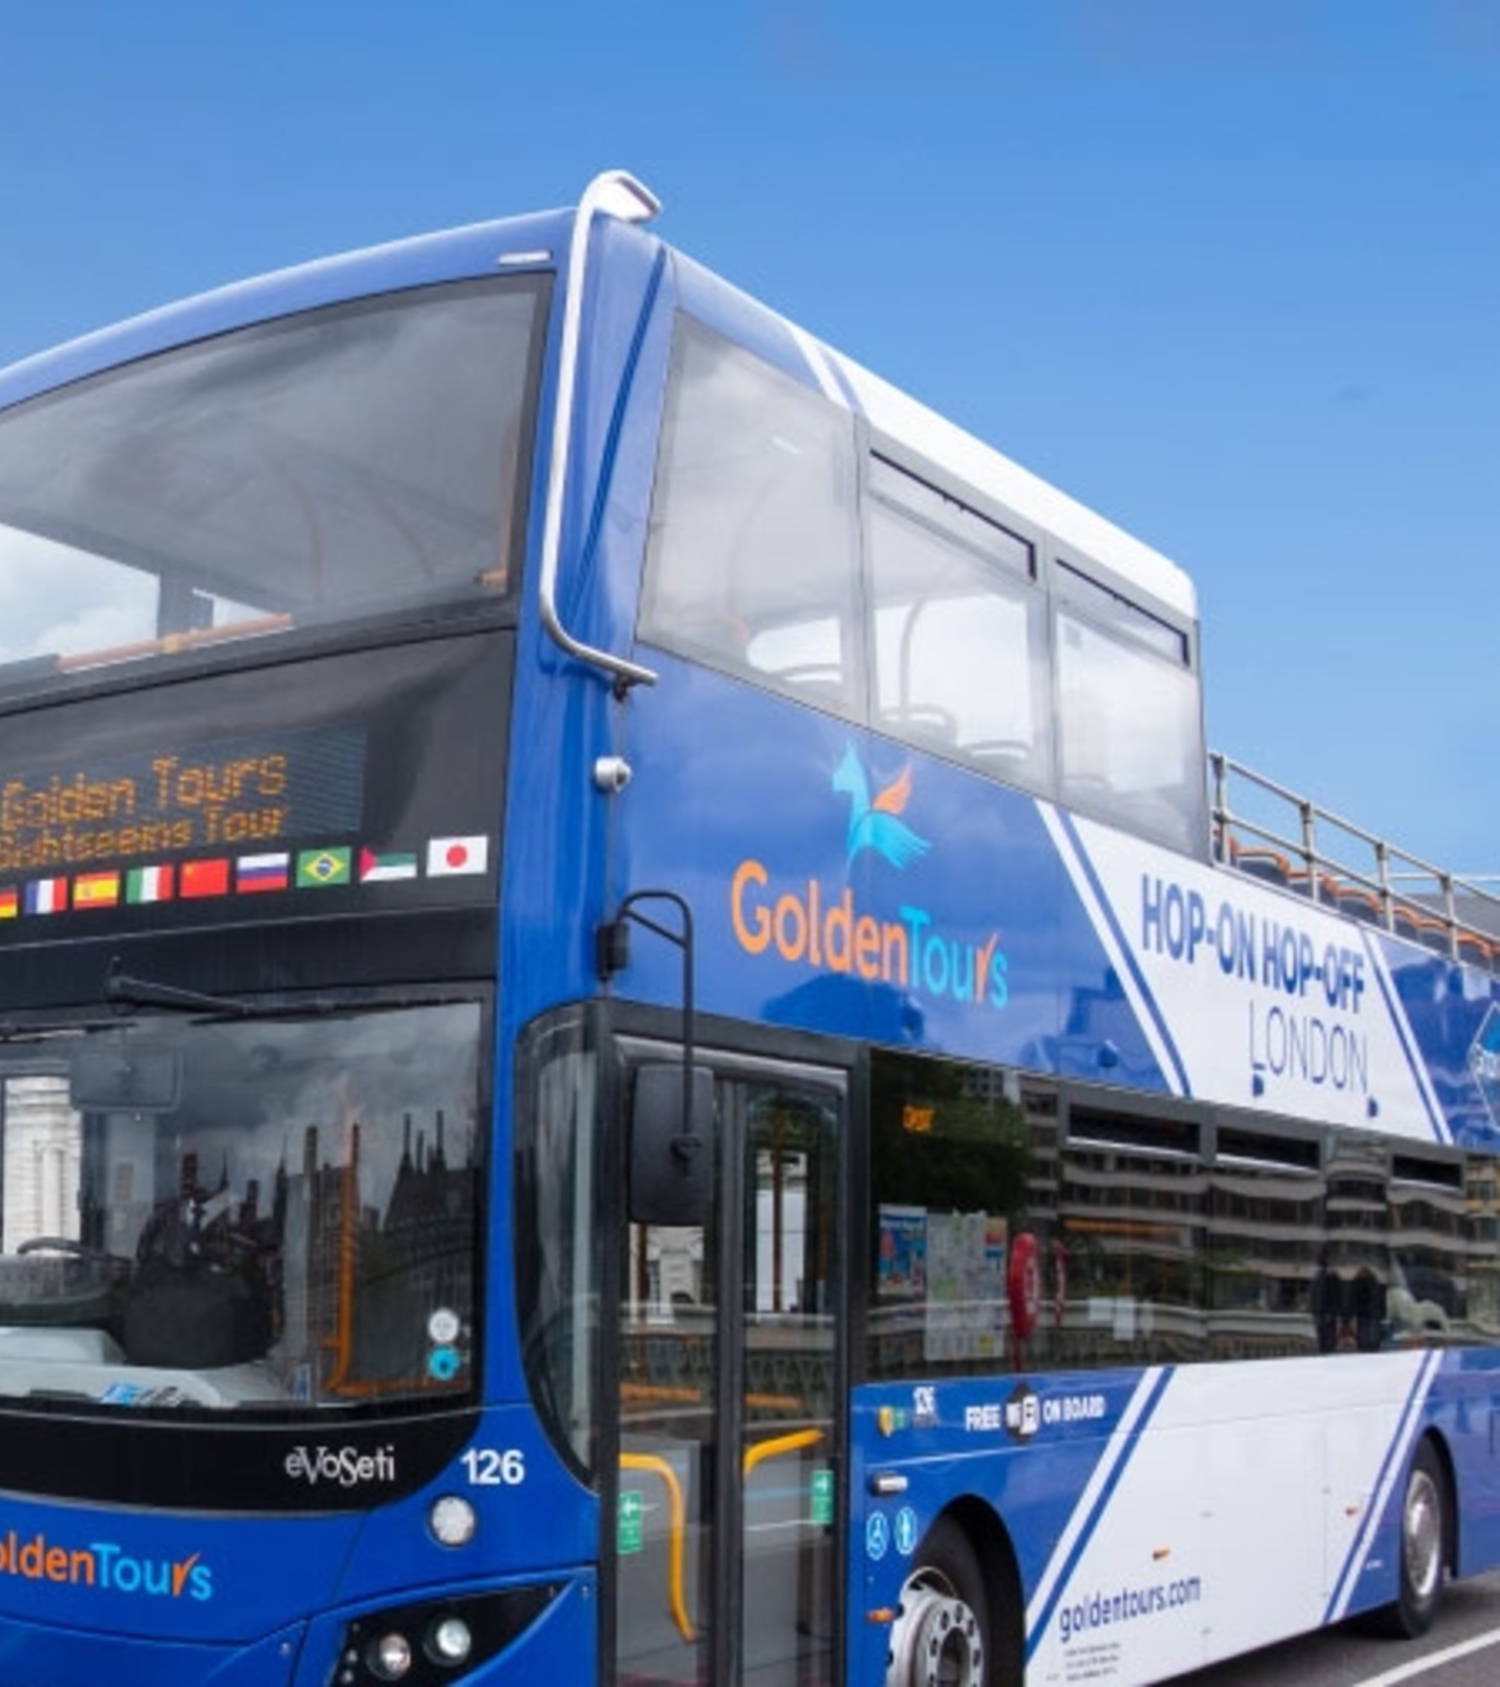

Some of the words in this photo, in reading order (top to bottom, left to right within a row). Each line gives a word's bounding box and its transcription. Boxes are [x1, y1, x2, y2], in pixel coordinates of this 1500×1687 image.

[152, 755, 286, 810] Tours
[204, 805, 286, 843] Tour
[731, 859, 1008, 1009] GoldenTours
[1142, 873, 1255, 982] HOP-ON
[1262, 919, 1364, 1014] HOP-OFF
[1248, 1000, 1368, 1095] LONDON
[966, 1405, 1000, 1432] FREE
[1043, 1399, 1061, 1425] ON
[1062, 1395, 1105, 1421] BOARD
[460, 1448, 526, 1485] 126
[1060, 1576, 1201, 1642] goldentours.com
